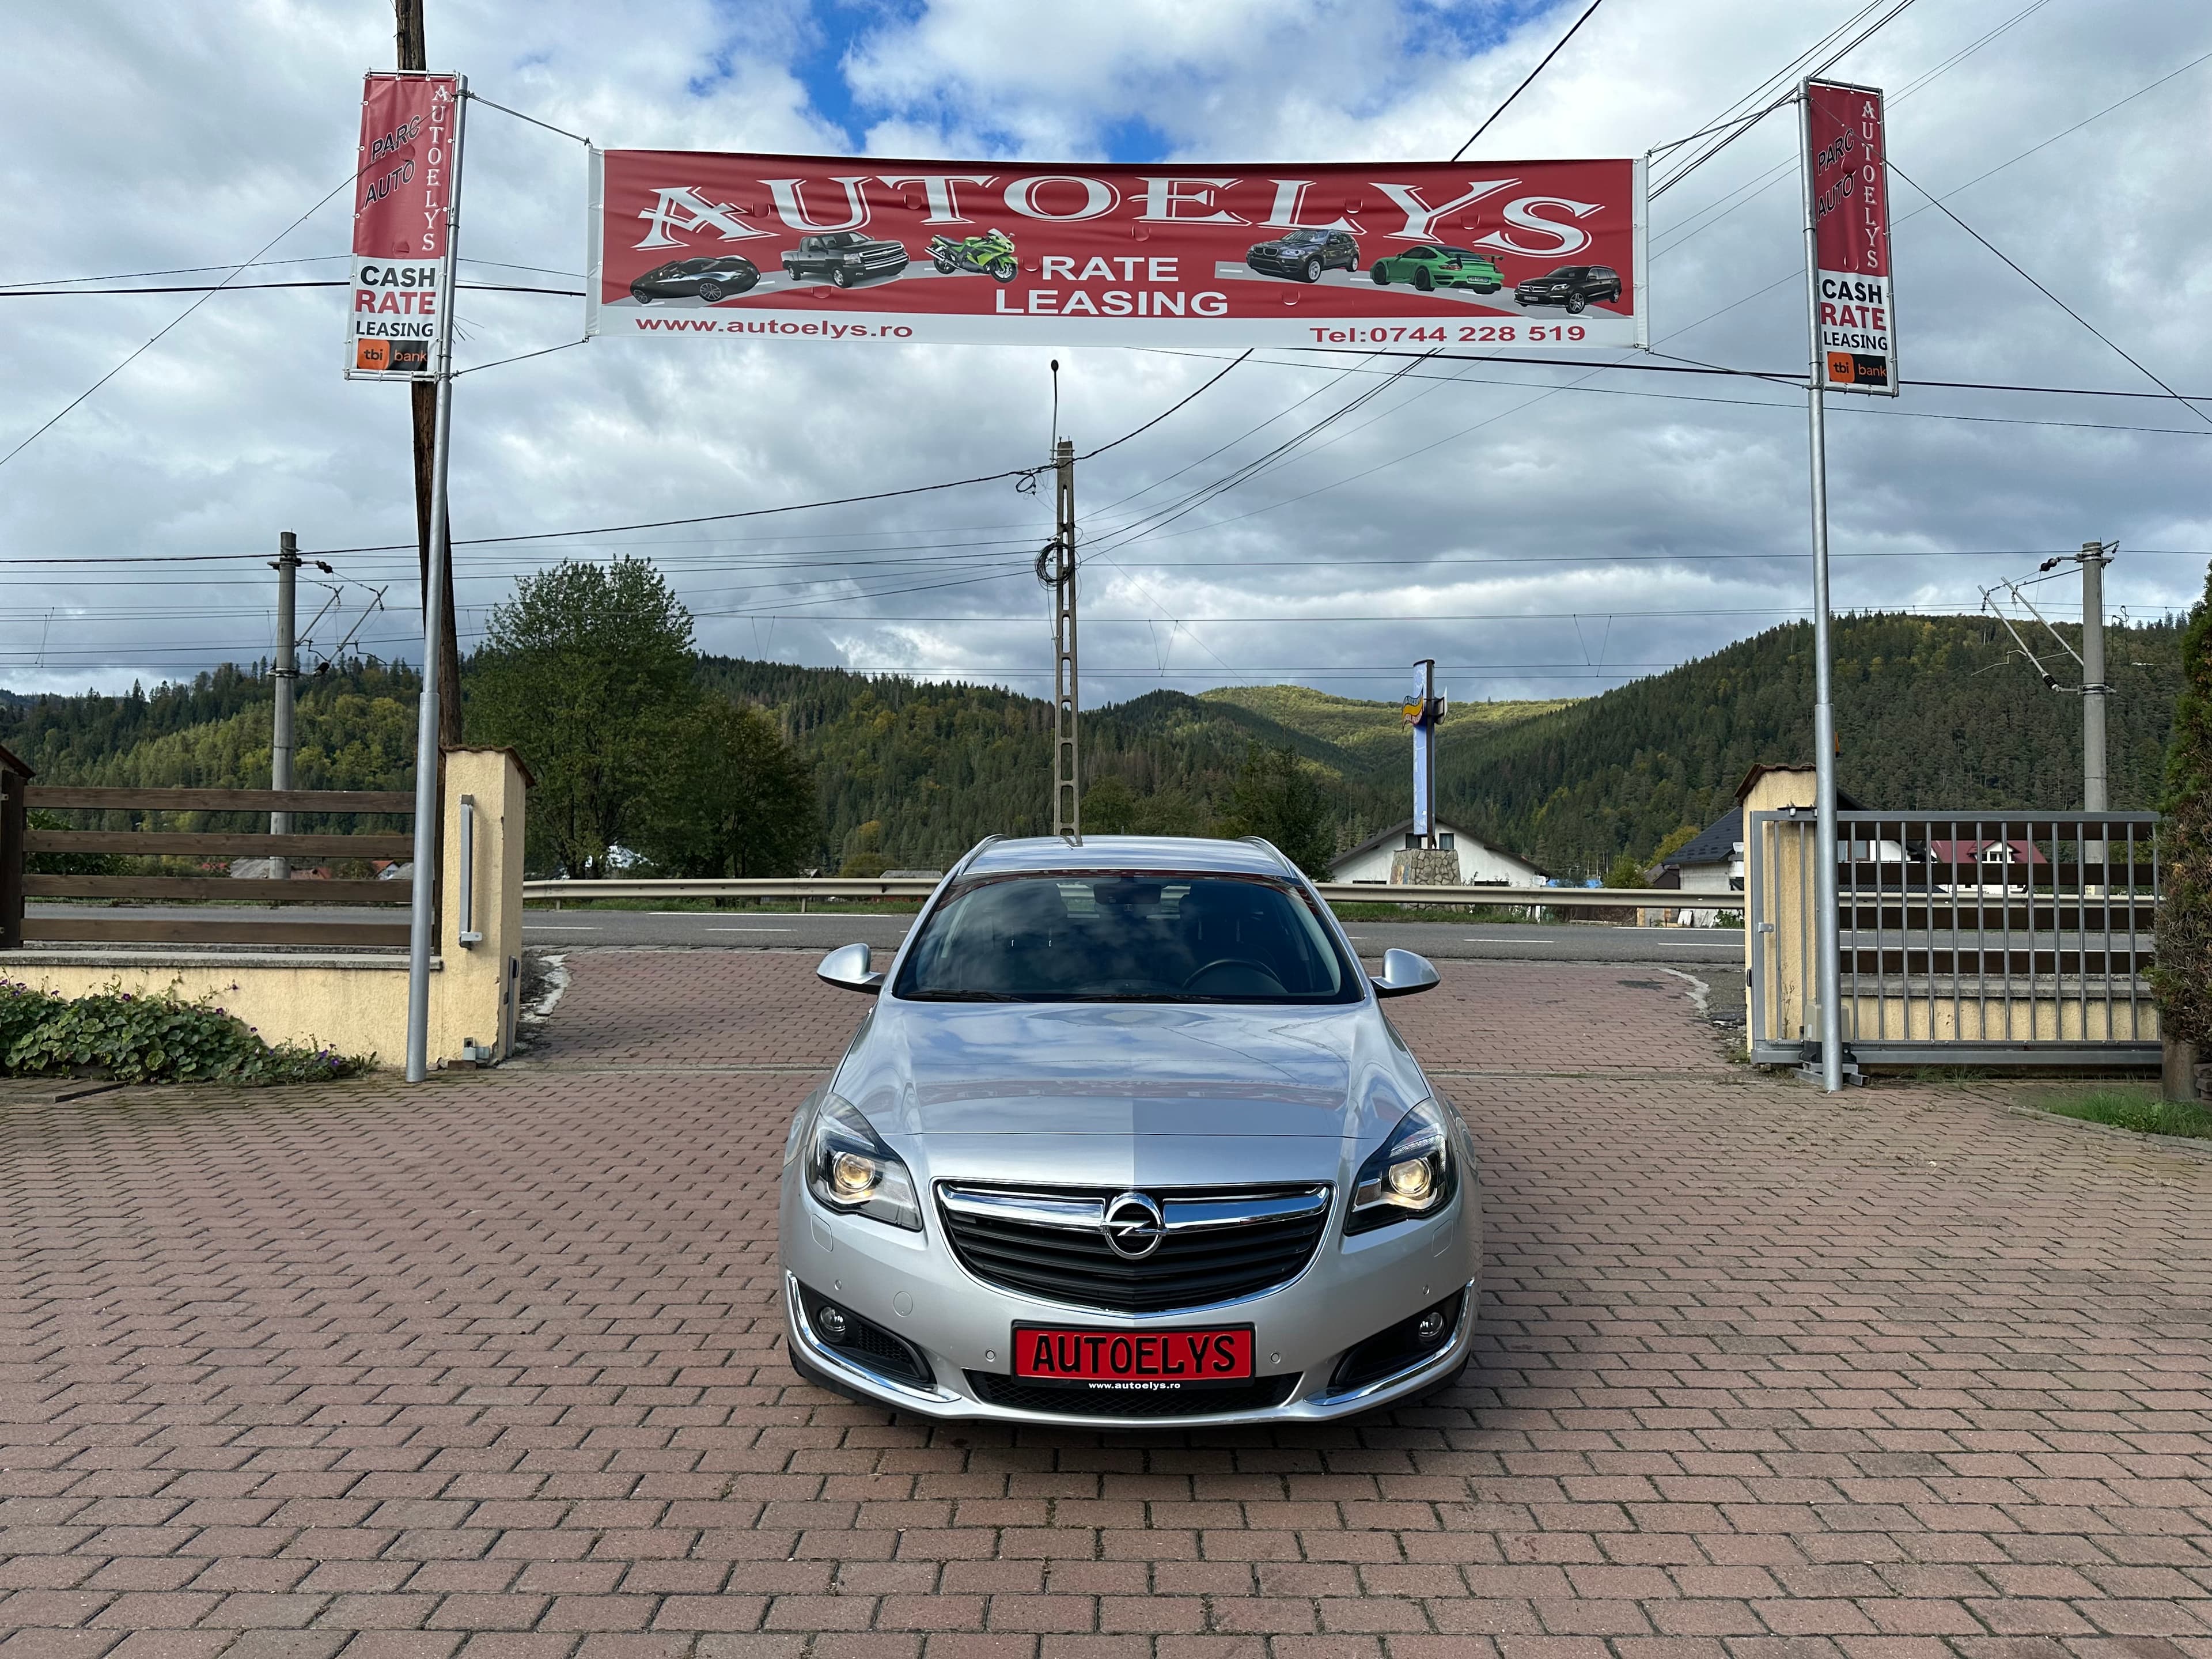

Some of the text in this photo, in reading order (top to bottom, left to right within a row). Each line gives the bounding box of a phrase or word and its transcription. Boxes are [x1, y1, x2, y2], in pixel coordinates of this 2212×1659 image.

[372, 115, 421, 164] PARC
[1818, 128, 1854, 176] PARC
[422, 85, 449, 251] AUTOELYS
[363, 159, 415, 210] AUTO
[1861, 100, 1881, 268] AUTOELYS
[1817, 173, 1855, 222] AUTO
[630, 175, 1607, 258] AUTOELYS
[361, 266, 435, 287] CASH
[1042, 256, 1179, 281] RATE
[355, 289, 437, 315] RATE
[996, 289, 1228, 316] LEASING
[1822, 279, 1883, 304] CASH
[356, 321, 433, 336] LEASING
[635, 316, 914, 339] www.autoelys.ro
[1820, 302, 1887, 331] RATE
[1309, 325, 1586, 342] Tel:0744 228 519
[1824, 331, 1888, 350] LEASING
[363, 349, 427, 362] tbi bank
[1833, 362, 1887, 376] tbi bank
[1032, 1334, 1236, 1374] AUTOELYS
[1089, 1382, 1181, 1391] www.autoelys.ro
